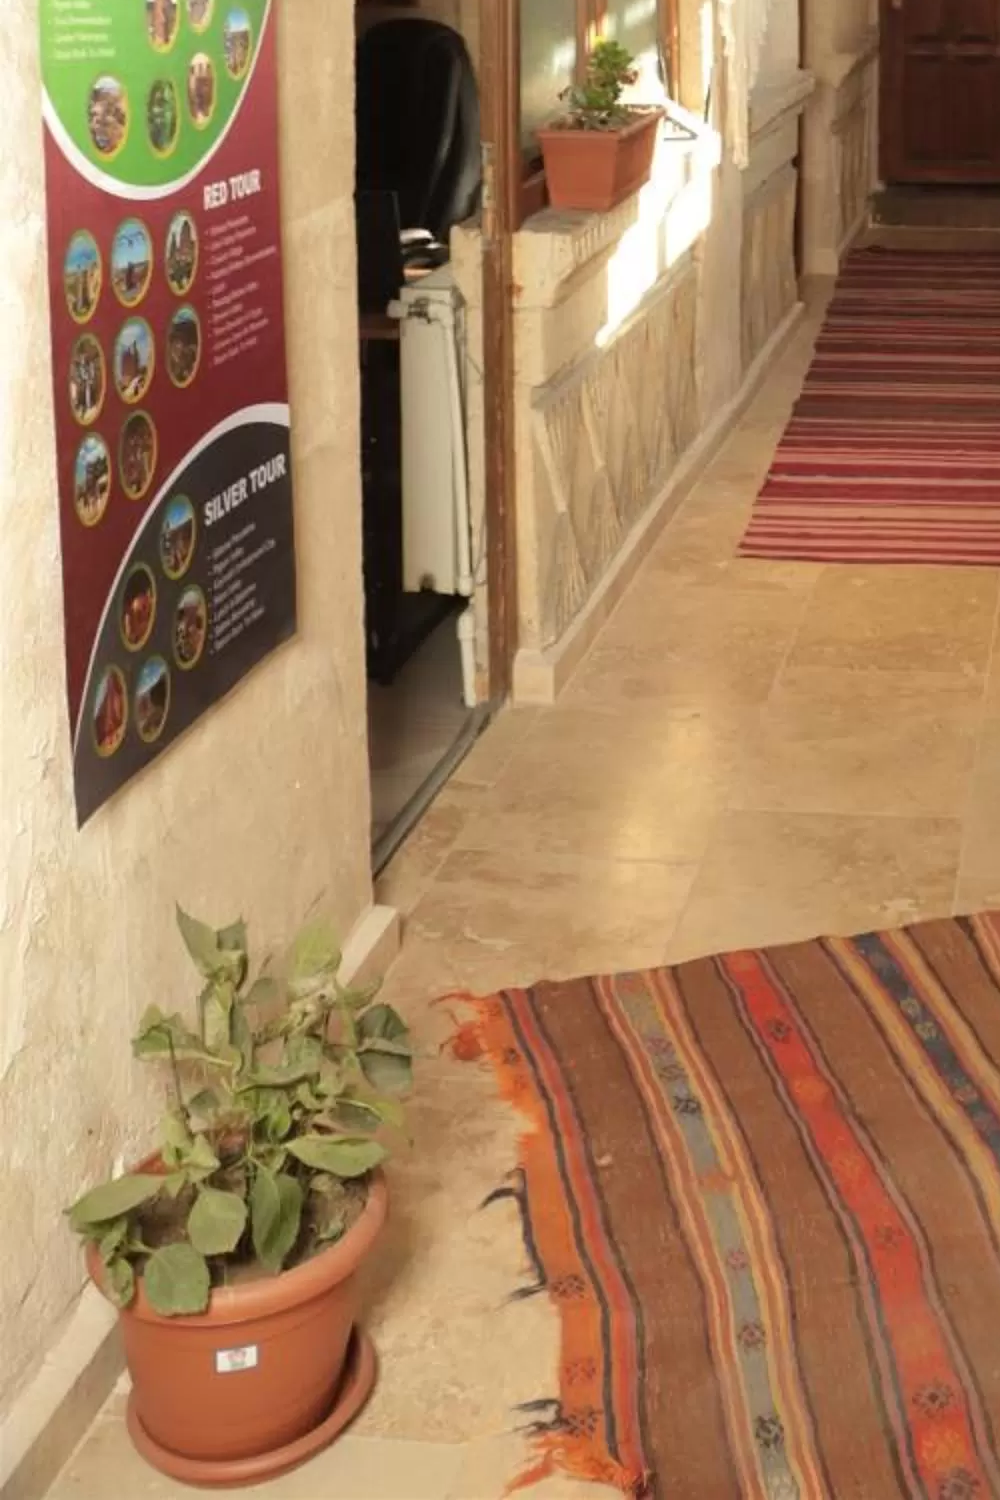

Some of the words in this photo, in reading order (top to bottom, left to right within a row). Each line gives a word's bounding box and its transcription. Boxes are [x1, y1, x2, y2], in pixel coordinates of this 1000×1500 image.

[203, 181, 228, 211] RED
[229, 168, 261, 200] TOUR
[204, 477, 248, 526] SILVER
[248, 453, 286, 493] TOUR
